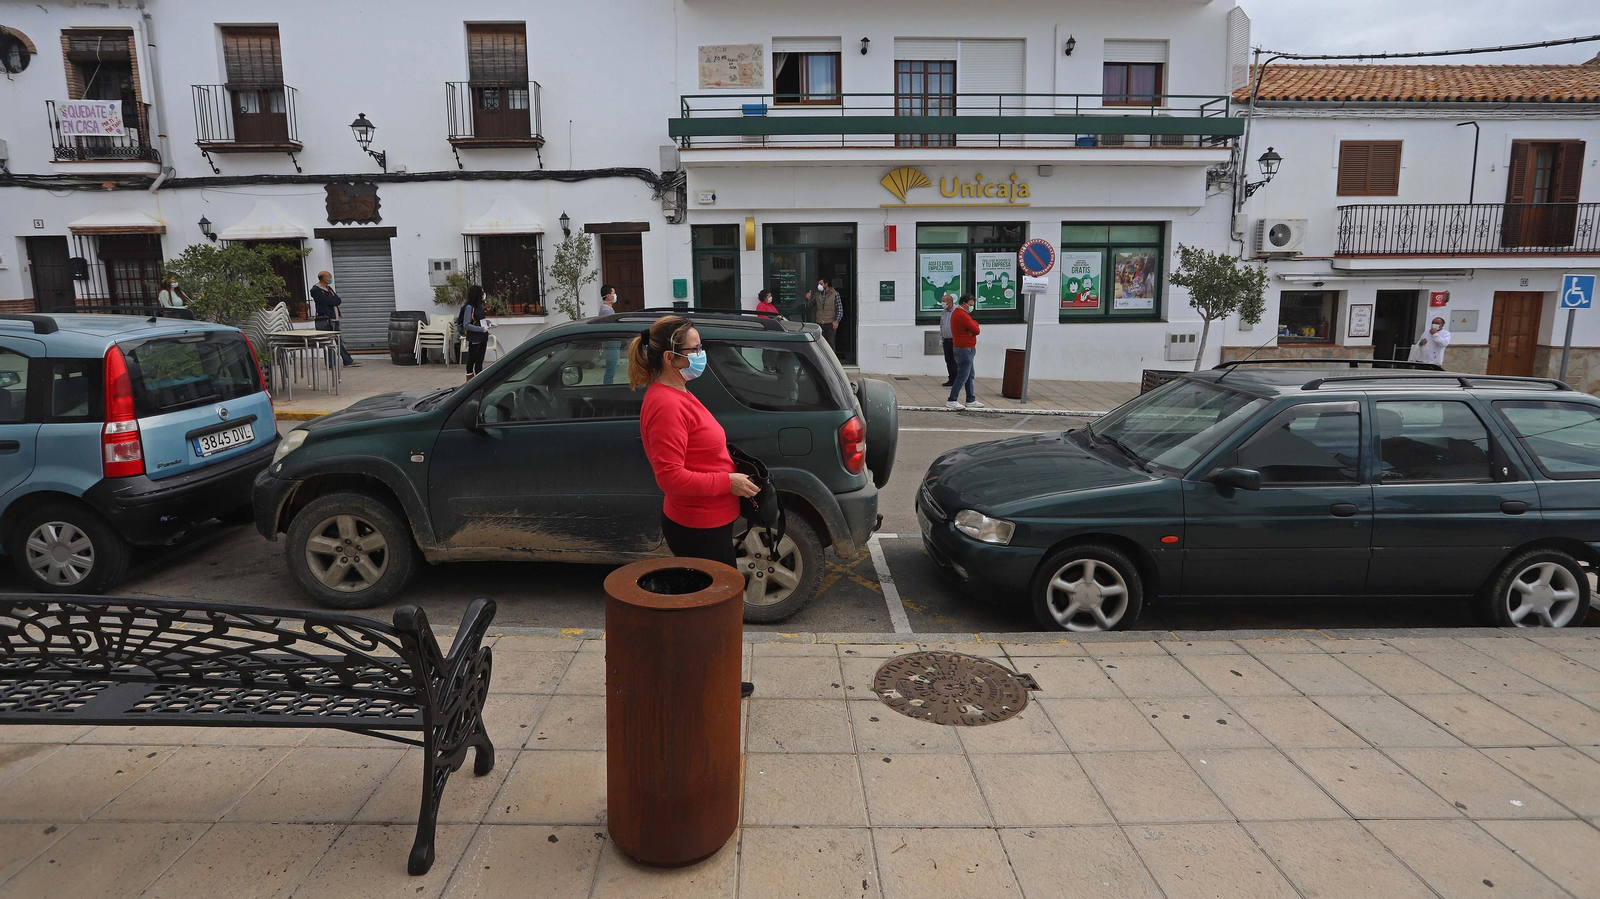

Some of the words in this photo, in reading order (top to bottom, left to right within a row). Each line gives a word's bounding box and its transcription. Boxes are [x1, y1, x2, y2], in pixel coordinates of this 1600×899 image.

[68, 105, 107, 118] QUEDATE
[62, 120, 74, 133] EN
[76, 120, 99, 133] CASA
[940, 173, 1030, 203] Unicaja
[202, 432, 231, 450] 3845
[231, 427, 251, 442] DVL
